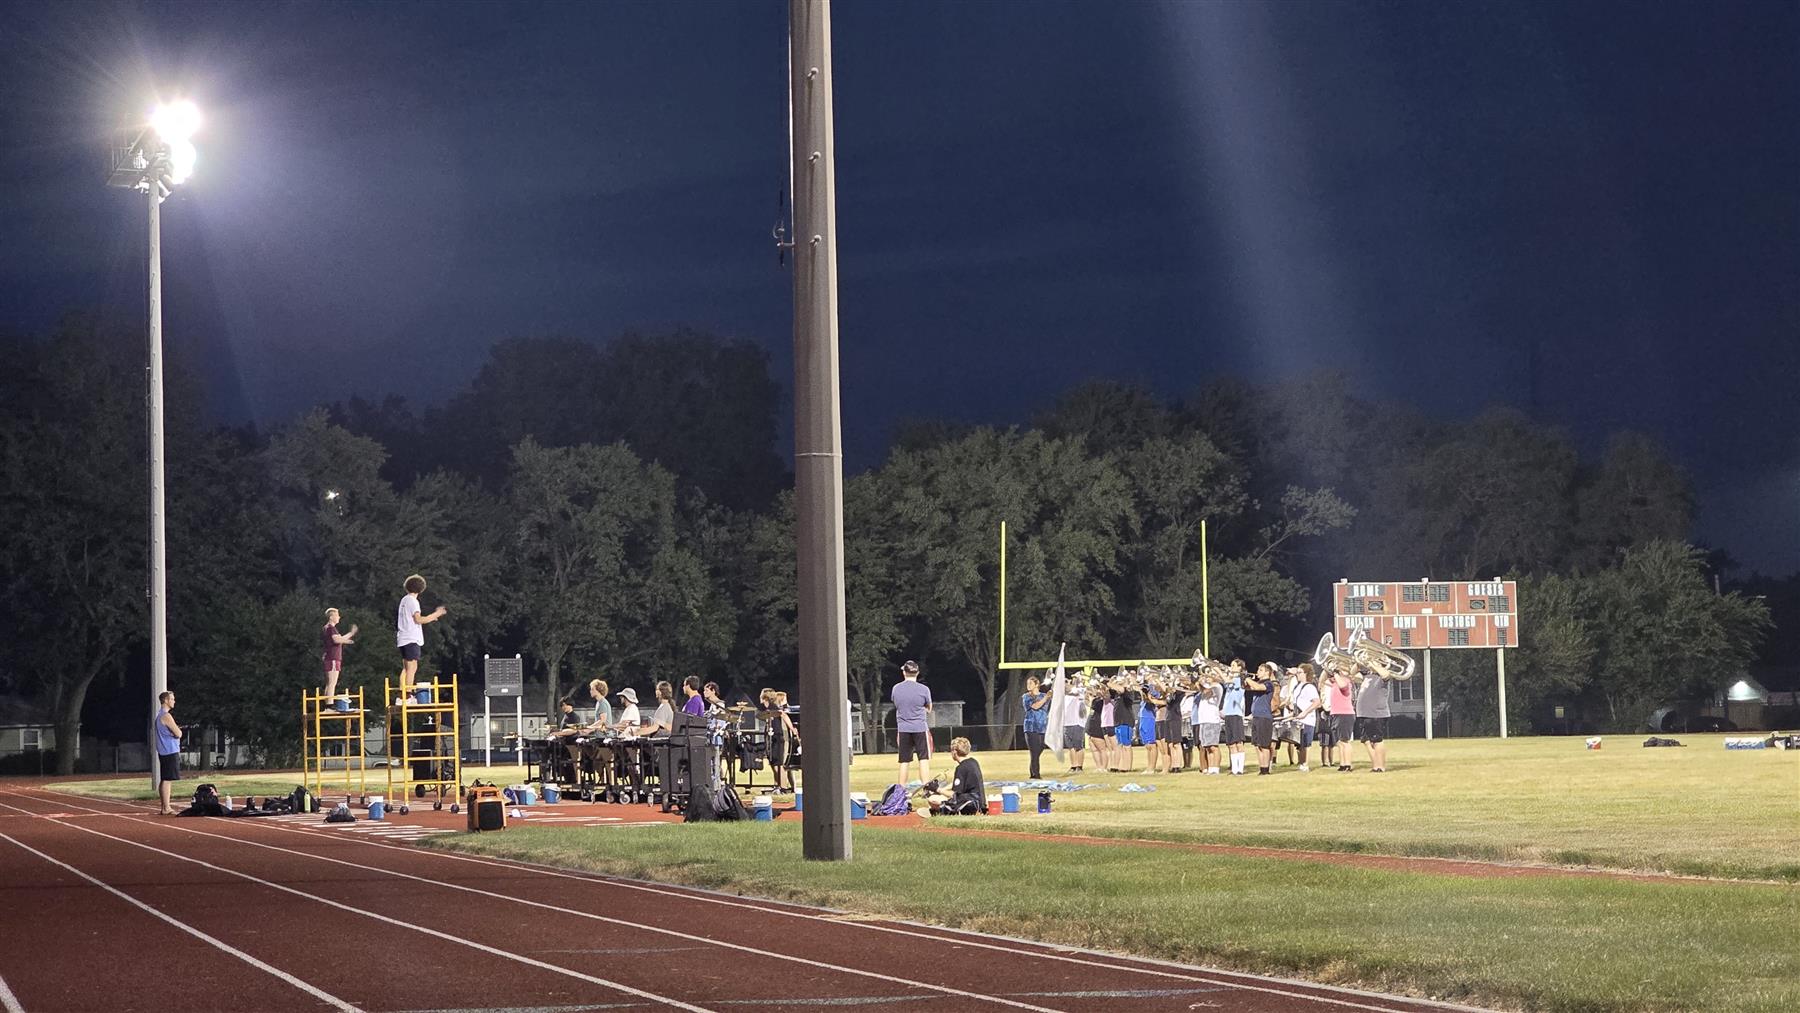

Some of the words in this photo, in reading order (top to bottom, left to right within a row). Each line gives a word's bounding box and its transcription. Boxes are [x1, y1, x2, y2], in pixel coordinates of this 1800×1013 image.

[1353, 585, 1379, 597] HOME
[1468, 584, 1504, 596] GUESTS
[1393, 616, 1417, 629] DOWN
